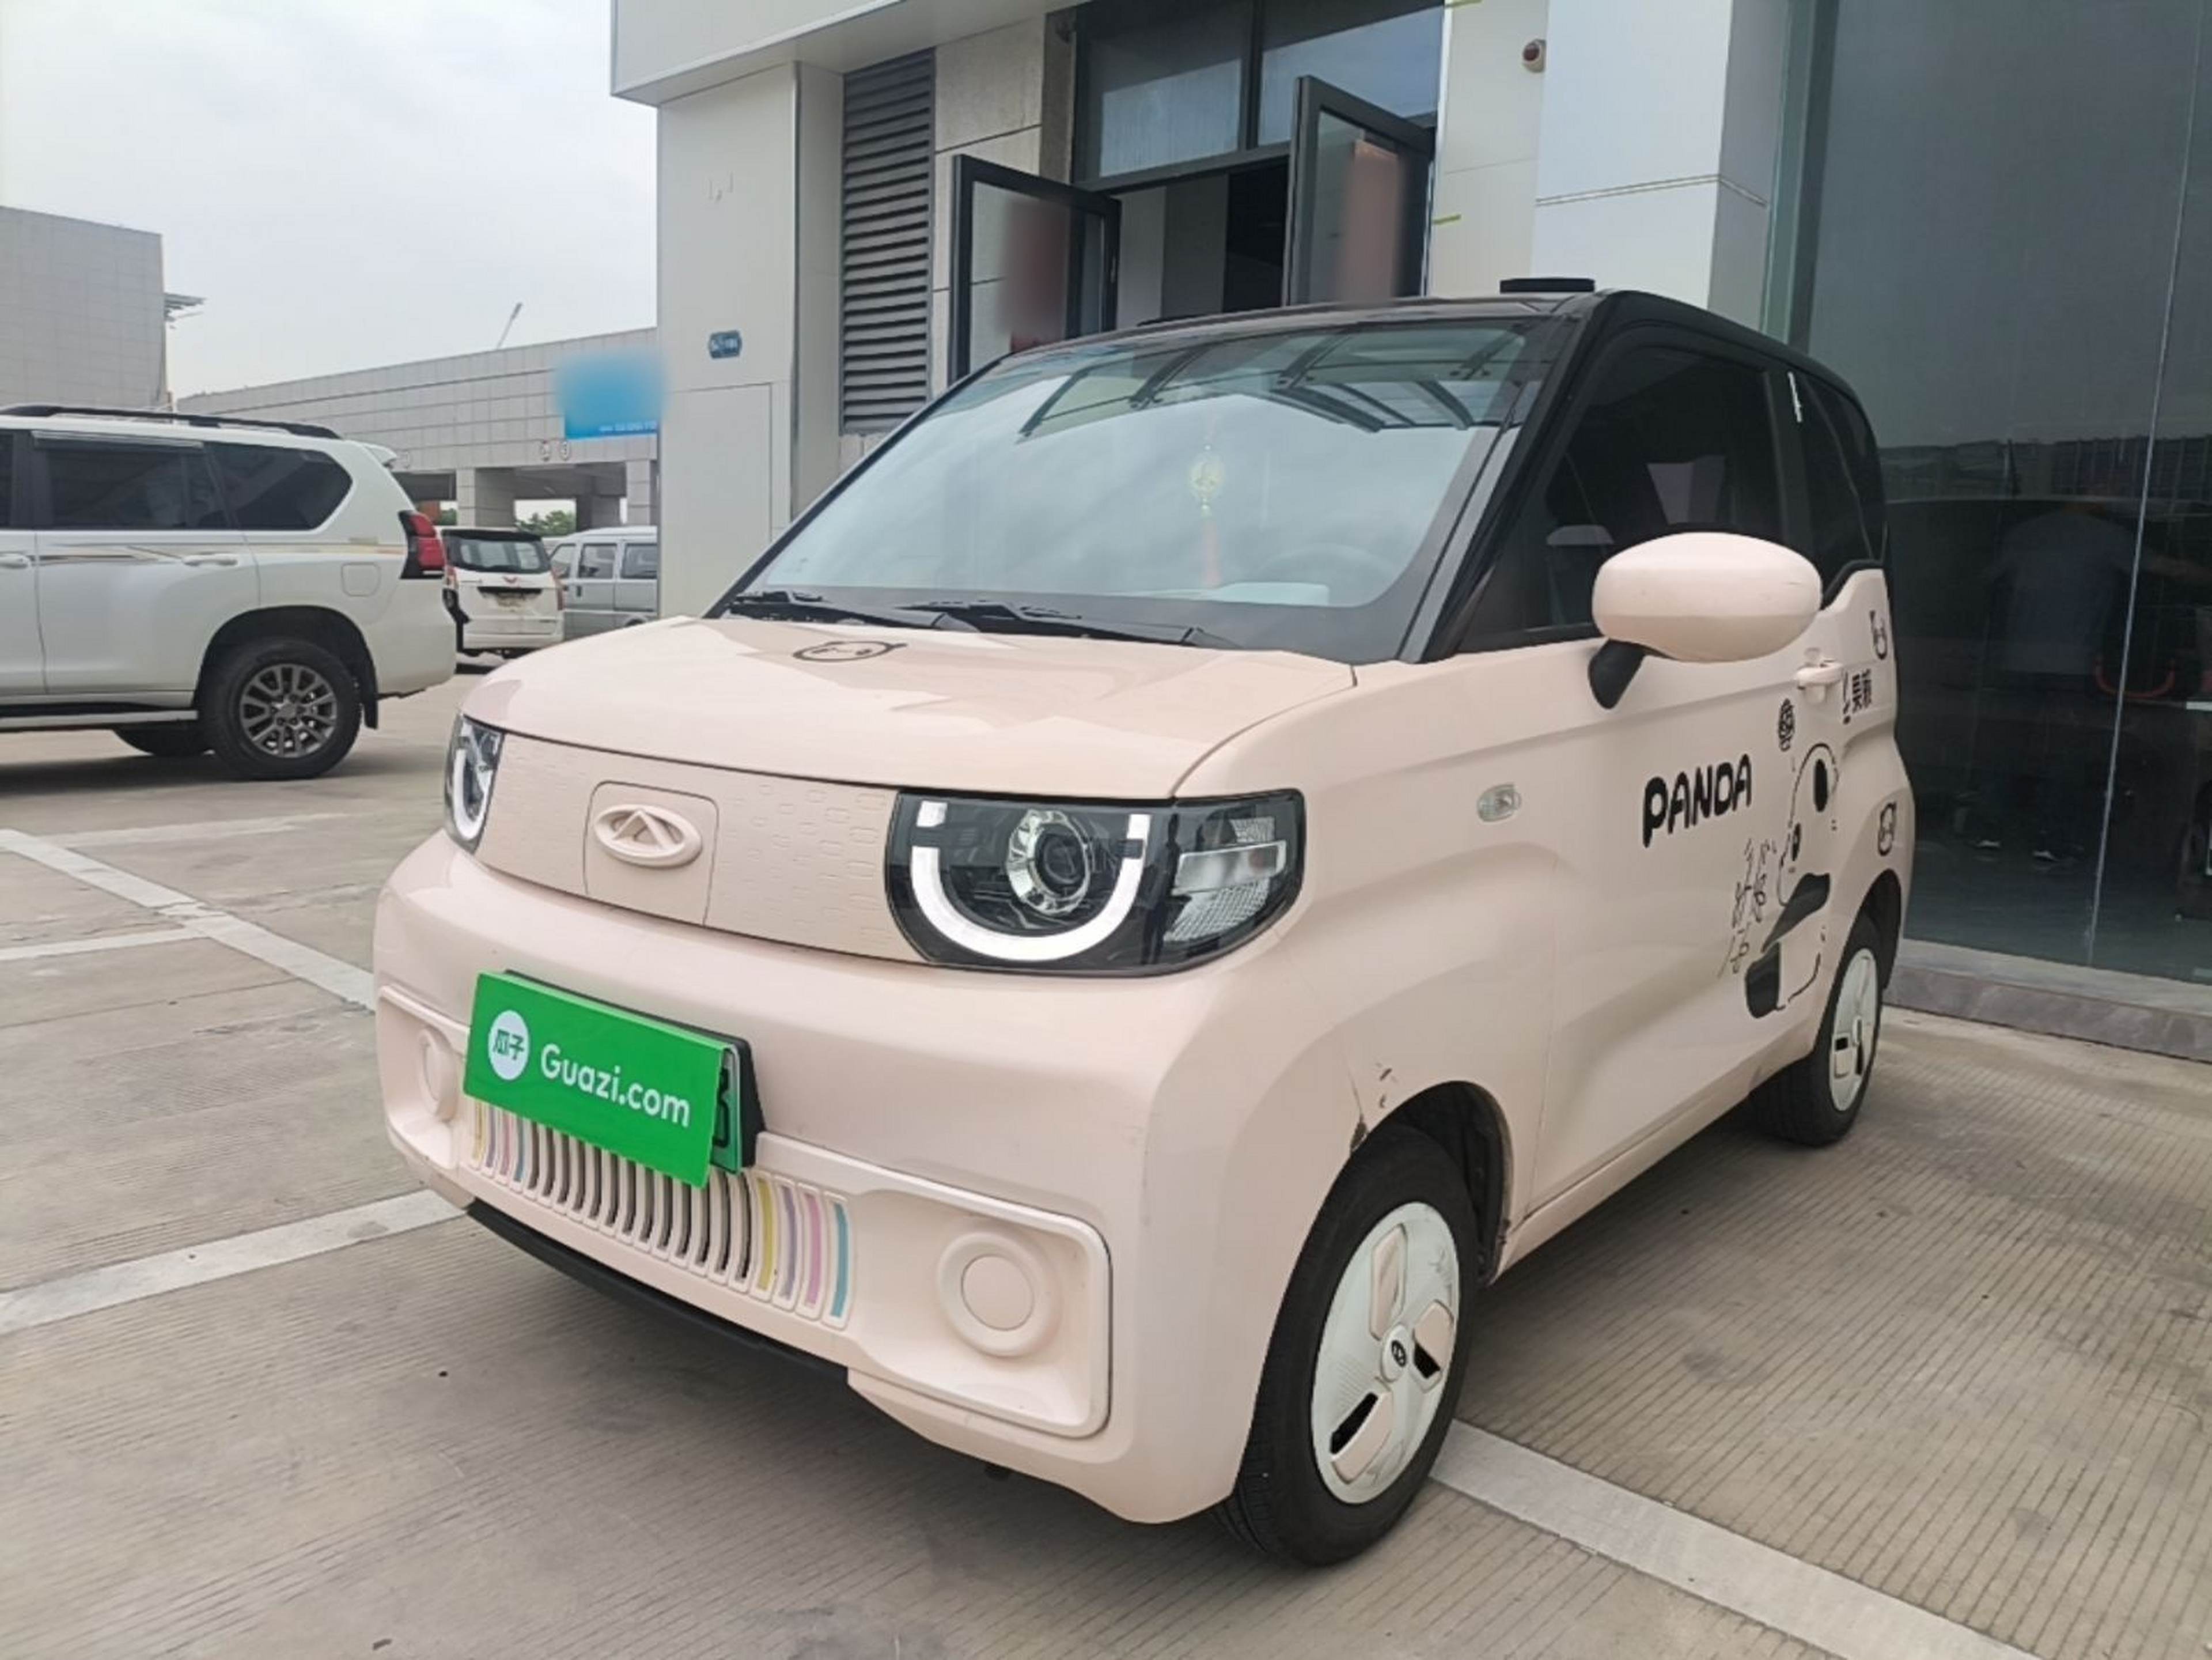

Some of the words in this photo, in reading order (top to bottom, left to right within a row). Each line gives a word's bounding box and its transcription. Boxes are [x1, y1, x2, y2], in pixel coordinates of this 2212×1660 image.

[1643, 754, 1752, 849] PANDA
[493, 1028, 525, 1061] 瓜子
[541, 1043, 690, 1128] Guazi.com
